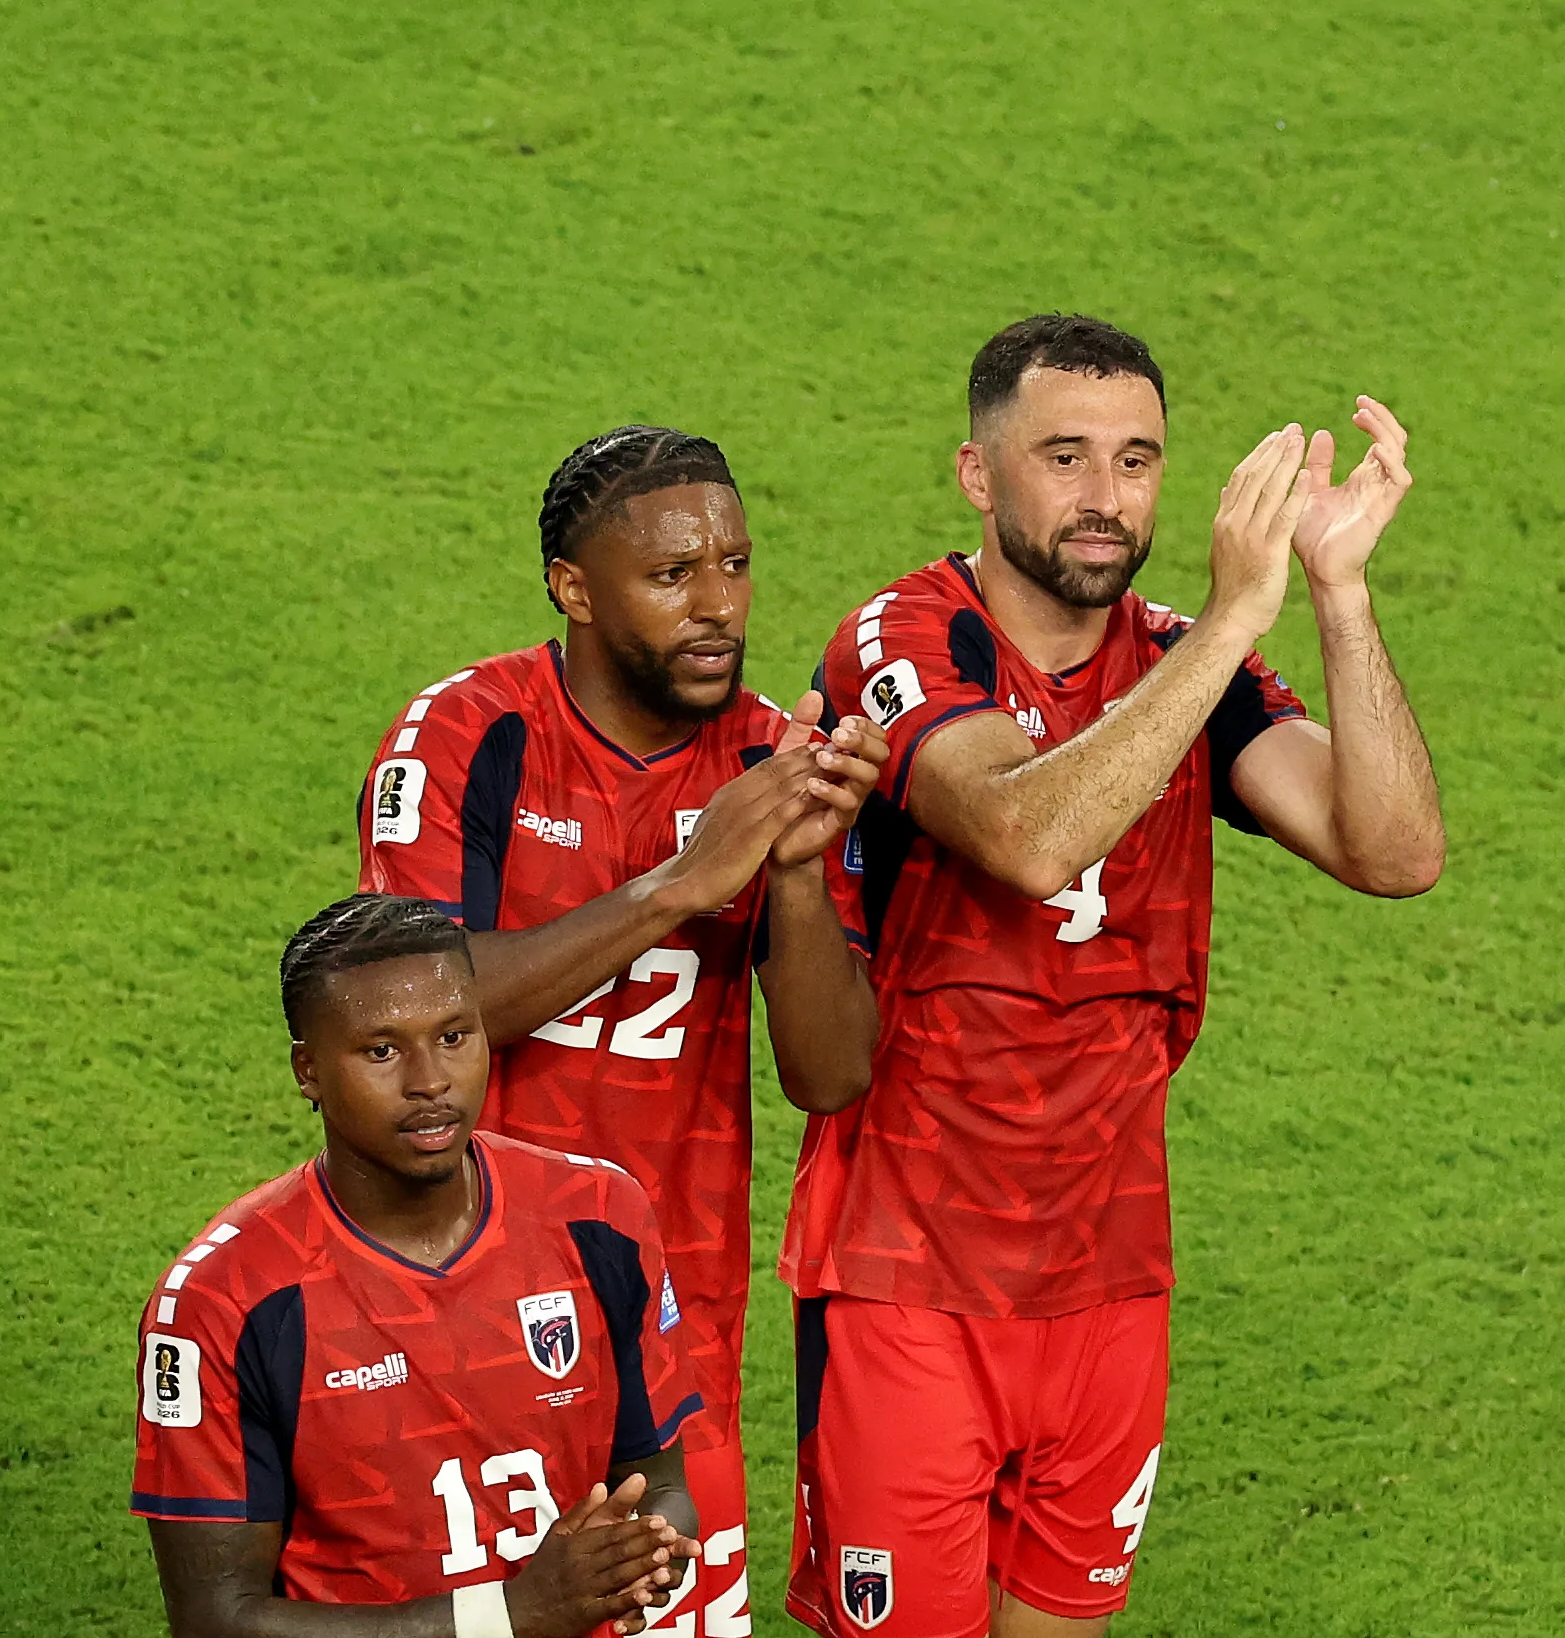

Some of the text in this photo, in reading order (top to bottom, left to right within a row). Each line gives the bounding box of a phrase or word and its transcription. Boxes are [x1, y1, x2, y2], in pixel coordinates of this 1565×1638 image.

[543, 833, 582, 851] SPORT
[524, 1296, 567, 1315] FCF
[326, 1352, 407, 1390] capelli
[367, 1374, 409, 1391] SPORT
[1111, 1442, 1161, 1555] 4
[433, 1448, 560, 1576] 13
[844, 1551, 886, 1566] FCF
